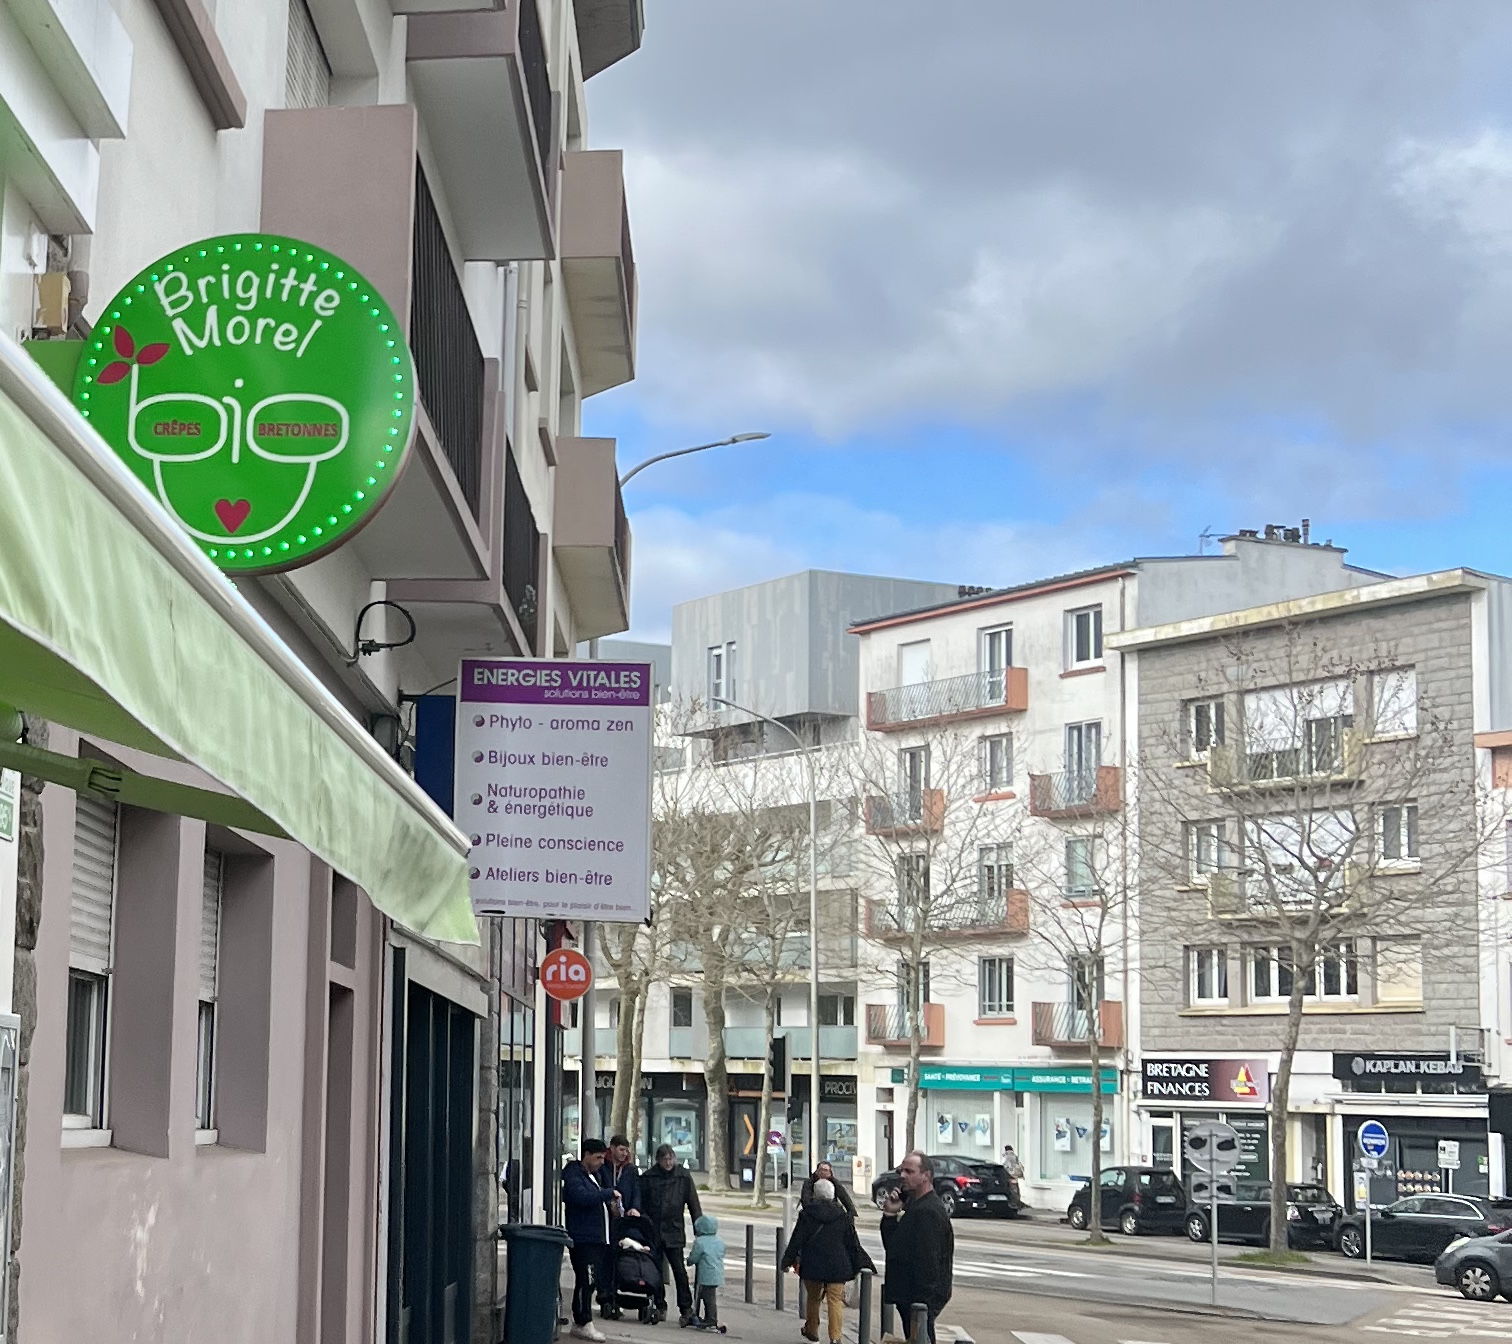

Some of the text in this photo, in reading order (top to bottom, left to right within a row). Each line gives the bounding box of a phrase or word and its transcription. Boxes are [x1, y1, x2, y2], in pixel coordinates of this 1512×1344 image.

[154, 263, 340, 317] Brigitte
[172, 305, 322, 358] Morel
[153, 419, 337, 438] CRÊPES BRETONNES
[473, 668, 641, 688] ENERGIES VITALES
[544, 689, 640, 700] solutions bien-être
[489, 714, 532, 732] Phyto
[550, 718, 600, 731] aroma
[606, 719, 633, 732] zen
[488, 750, 609, 768] Bijoux bien-être
[487, 783, 585, 802] Naturopathie
[487, 799, 594, 819] & énergétique
[486, 833, 624, 852] Pleine conscience
[485, 867, 613, 886] Ateliers bien-être
[546, 956, 586, 981] ria
[1147, 1063, 1209, 1077] BRETAGNE
[1365, 1060, 1417, 1074] KAPLAN
[1147, 1081, 1210, 1096] FINANCES
